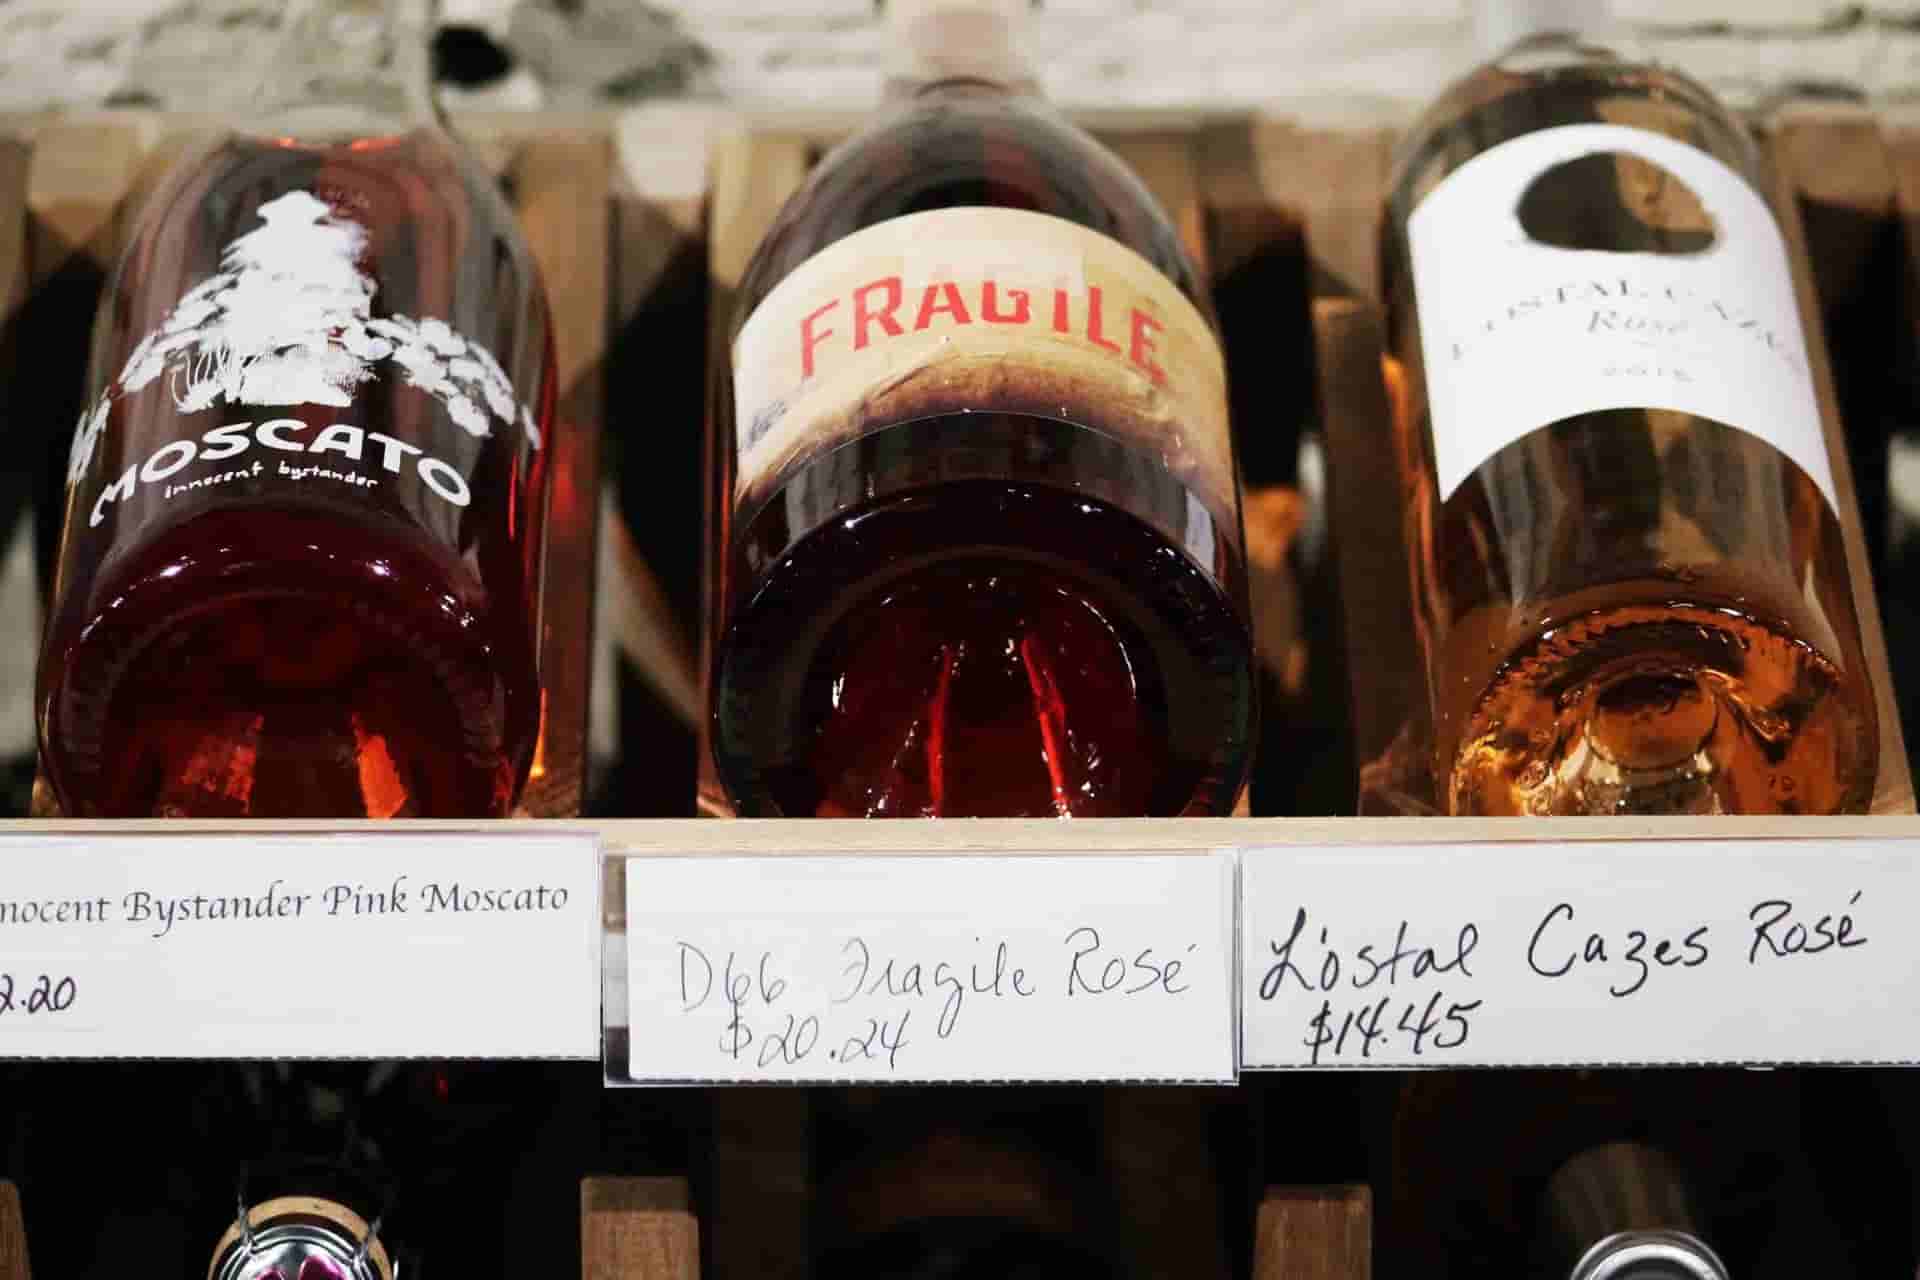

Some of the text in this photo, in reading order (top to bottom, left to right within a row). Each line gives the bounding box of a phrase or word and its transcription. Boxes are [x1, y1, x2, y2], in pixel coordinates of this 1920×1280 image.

[799, 276, 1169, 390] FRAGILE
[89, 419, 471, 528] MOSCATO
[164, 459, 379, 499] innocent bystander
[123, 880, 312, 938] Bystander
[322, 875, 408, 916] Pink
[420, 882, 568, 912] Moscato
[1526, 903, 1711, 998] Cazes
[1748, 889, 1868, 965] Rosé
[675, 927, 1200, 1039] D66 Fragile Rosé
[1303, 991, 1483, 1065] $14.45
[718, 1002, 912, 1070] $20.24
